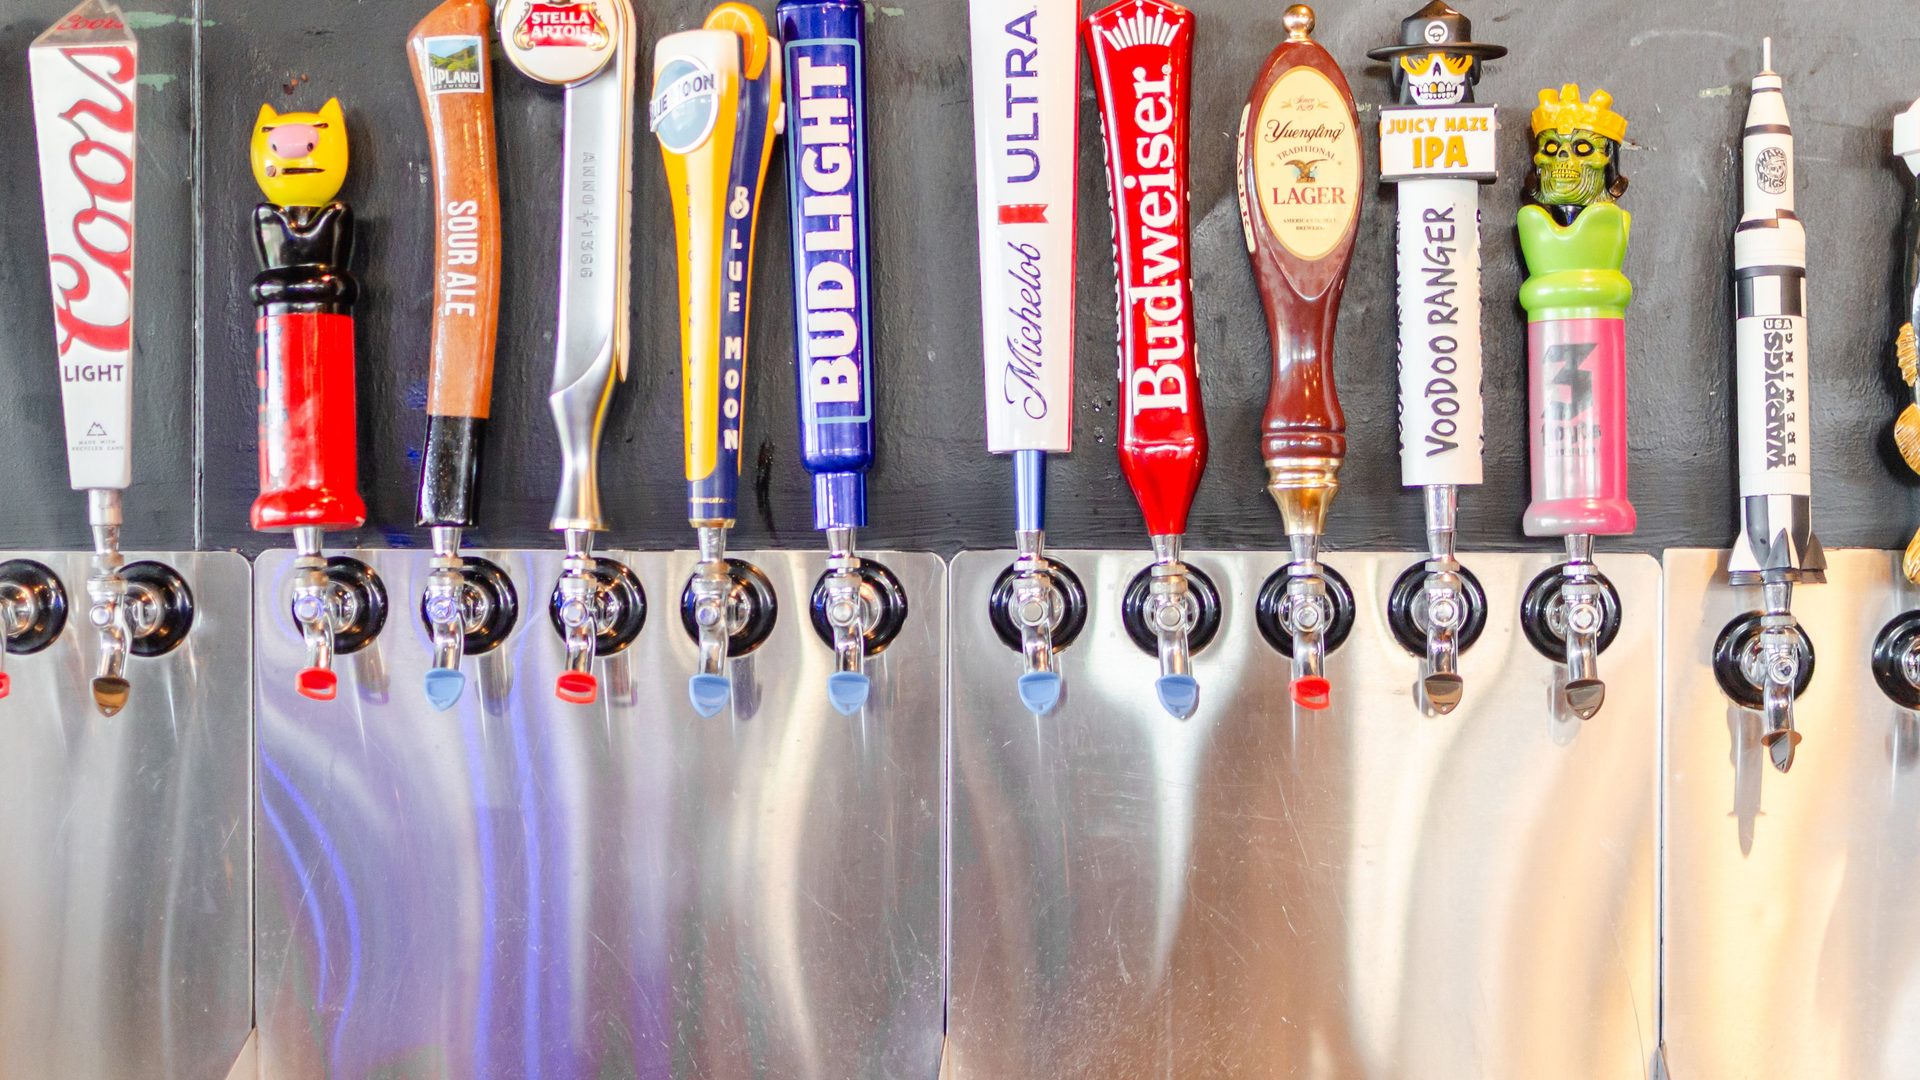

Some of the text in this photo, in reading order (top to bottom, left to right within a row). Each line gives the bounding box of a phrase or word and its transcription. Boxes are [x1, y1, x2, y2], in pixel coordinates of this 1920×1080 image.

[531, 11, 591, 24] STELLA
[531, 25, 591, 39] ARTOIS
[430, 66, 480, 85] UPLAND
[1264, 119, 1346, 143] Yuengling
[1276, 145, 1336, 161] TRADITIONAL
[1386, 116, 1489, 135] JUICY HAZE
[1412, 135, 1469, 169] IPA
[50, 46, 136, 356] Coors
[580, 151, 597, 279] ANNO 1366
[1003, 9, 1047, 419] Michelob ULTRA
[1272, 187, 1346, 205] LAGER
[798, 56, 859, 402] BUD LIGHT
[445, 200, 478, 318] SOUR ALE
[723, 186, 750, 450] BLUE MOON
[1421, 207, 1460, 457] VOODOO RANGER
[1765, 319, 1791, 329] USA
[64, 364, 124, 382] LIGHT
[1541, 343, 1597, 420] 3
[1764, 331, 1786, 470] WARPIGS
[1785, 333, 1796, 466] BREWING
